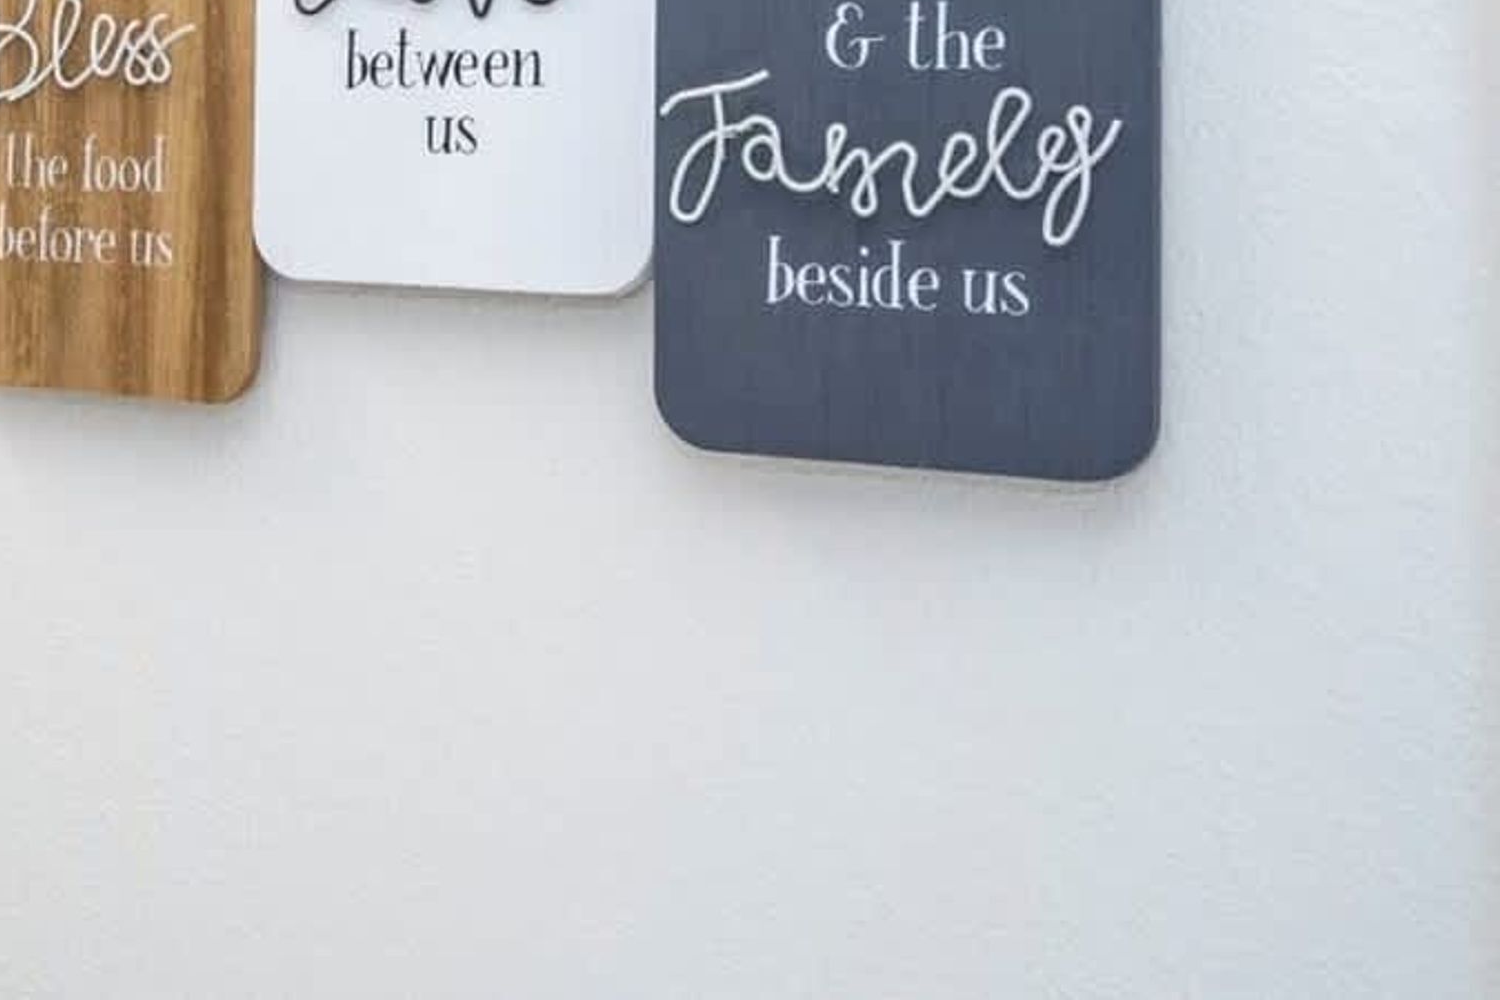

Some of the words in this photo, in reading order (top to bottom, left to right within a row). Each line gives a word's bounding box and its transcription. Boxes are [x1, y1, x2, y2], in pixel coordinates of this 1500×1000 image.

[345, 27, 545, 90] between
[824, 1, 887, 71] &
[904, 0, 1007, 71] the
[4, 131, 69, 192] the
[81, 132, 167, 193] food
[424, 114, 478, 155] us
[130, 230, 174, 267] us
[765, 235, 941, 311] beside
[961, 267, 1032, 317] us
